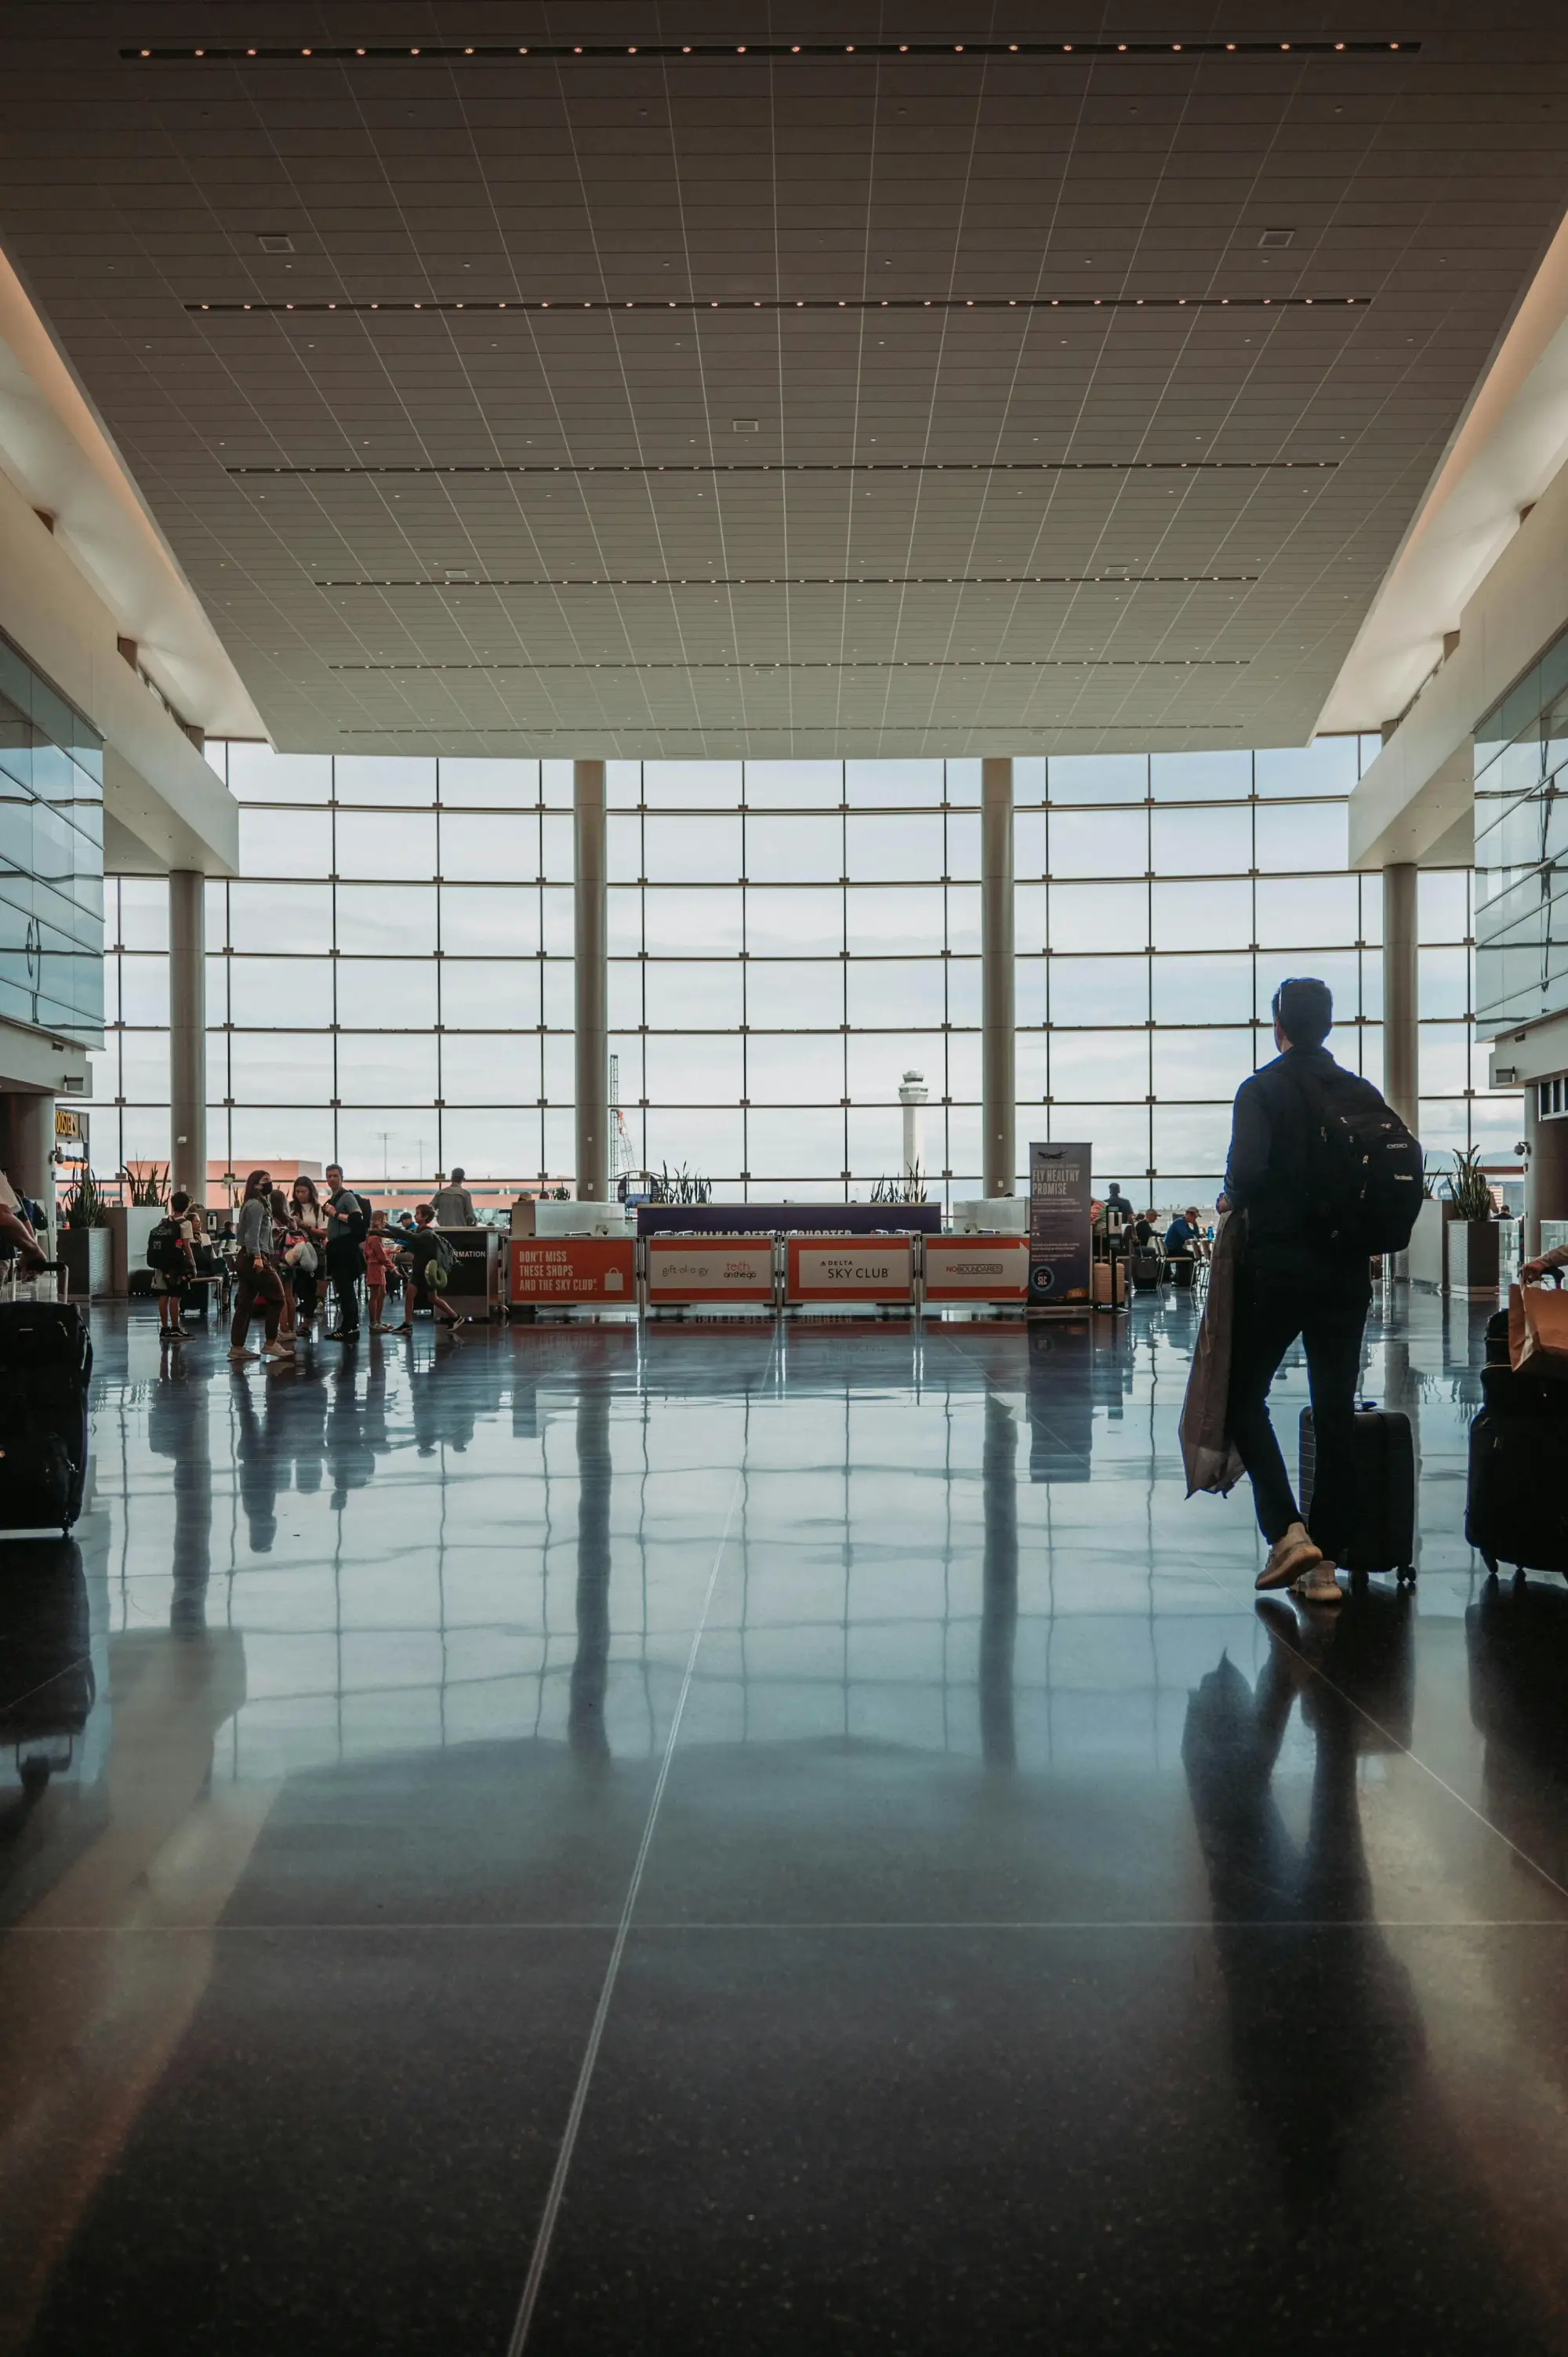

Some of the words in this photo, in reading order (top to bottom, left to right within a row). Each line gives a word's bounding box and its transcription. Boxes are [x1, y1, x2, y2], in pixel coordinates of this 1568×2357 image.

[1032, 1169, 1045, 1182] FLY
[1047, 1169, 1080, 1182] HEALTHY
[1032, 1182, 1067, 1195] PROMISE
[519, 1251, 543, 1262] DON'T
[545, 1251, 567, 1262] MISS
[519, 1265, 544, 1277] THESE
[546, 1265, 574, 1277] SHOPS
[727, 1262, 750, 1271] tech
[828, 1268, 852, 1279] SKY
[855, 1268, 888, 1279] CLUB
[519, 1280, 536, 1291] AND
[539, 1280, 554, 1291] THE
[555, 1280, 571, 1291] SKY
[1037, 1276, 1047, 1285] SLC
